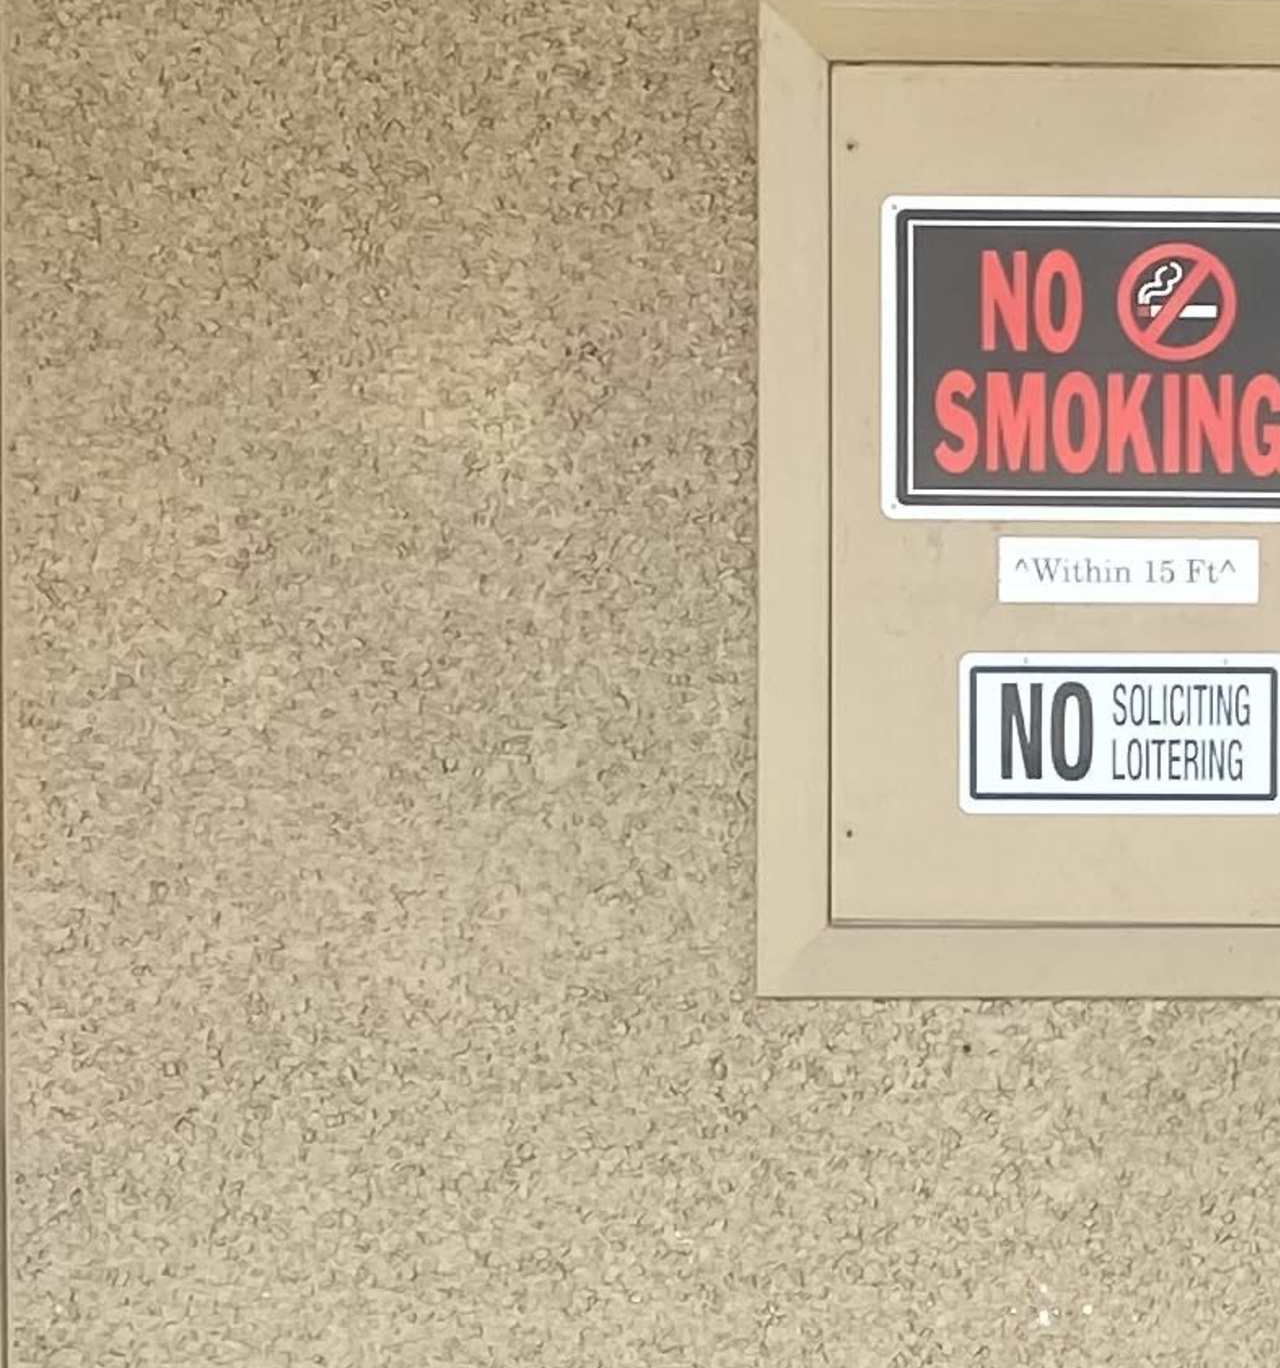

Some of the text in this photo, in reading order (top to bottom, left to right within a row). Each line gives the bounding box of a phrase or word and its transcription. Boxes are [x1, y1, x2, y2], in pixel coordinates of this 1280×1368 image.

[980, 248, 1083, 355] NO
[1145, 559, 1175, 583] 15
[1111, 683, 1251, 727] SOLICITING
[1000, 680, 1094, 782] NO
[1111, 738, 1244, 783] LOITERING
